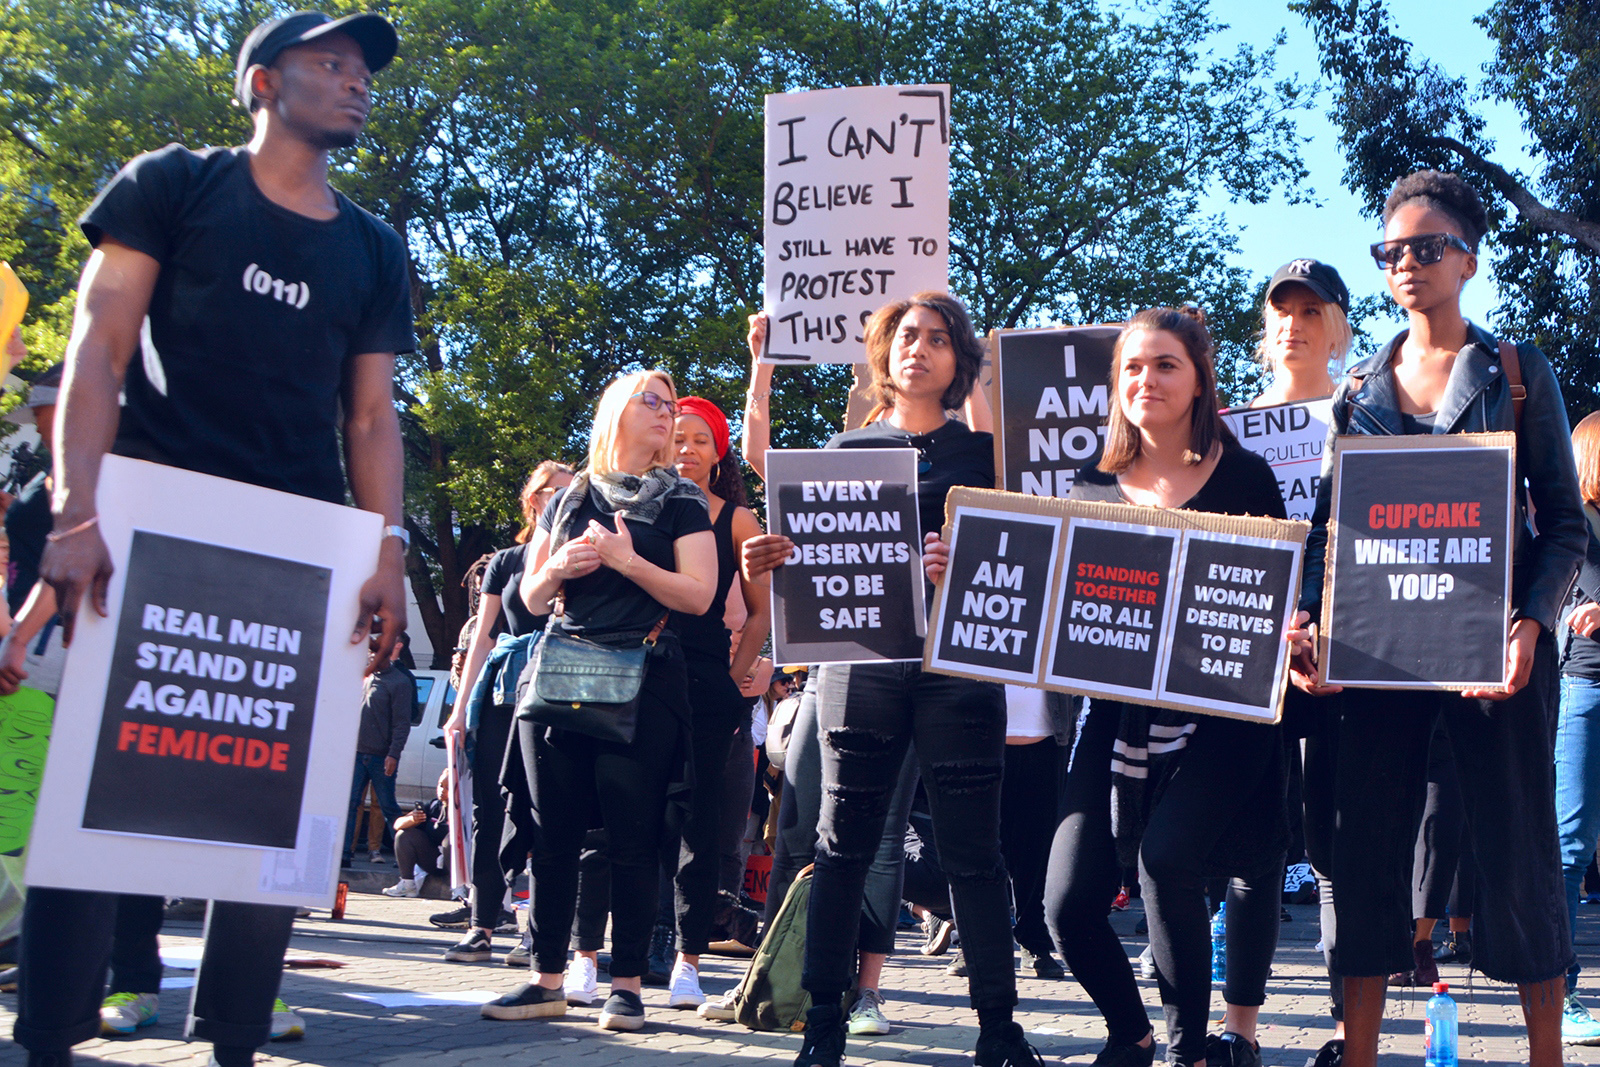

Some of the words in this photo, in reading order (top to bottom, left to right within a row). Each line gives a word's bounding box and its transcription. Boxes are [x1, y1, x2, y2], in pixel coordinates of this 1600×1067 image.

[778, 116, 808, 166] I
[827, 113, 936, 160] CAN'T
[772, 181, 874, 226] BELIEVE
[890, 176, 915, 209] I
[778, 239, 832, 262] STILL
[845, 236, 896, 257] HAVE
[907, 236, 938, 257] TO
[242, 262, 310, 310] (011)
[780, 268, 896, 302] PROTEST
[778, 311, 848, 345] THIS
[1064, 344, 1076, 378] I
[1035, 384, 1109, 419] AM
[1243, 405, 1311, 439] END
[1263, 439, 1326, 463] CULTU
[801, 479, 883, 502] EVERY
[1021, 468, 1082, 498] NE
[786, 511, 901, 534] WOMAN
[1368, 502, 1481, 529] CUPCAKE
[784, 542, 910, 566] DESERVES
[998, 531, 1009, 557] I
[1354, 537, 1440, 565] WHERE
[1443, 537, 1492, 564] ARE
[811, 575, 849, 597] TO
[854, 574, 885, 596] BE
[971, 560, 1024, 591] AM
[1076, 562, 1160, 587] STANDING
[1207, 563, 1267, 587] EVERY
[1387, 573, 1455, 601] YOU?
[961, 590, 1027, 623] NOT
[1074, 580, 1157, 605] TOGETHER
[1194, 584, 1274, 612] WOMAN
[141, 603, 223, 643] REAL
[228, 618, 302, 655] MEN
[819, 606, 881, 630] SAFE
[1070, 600, 1114, 624] FOR
[1116, 605, 1154, 630] ALL
[1185, 607, 1274, 635] DESERVES
[951, 621, 1028, 656] NEXT
[1068, 623, 1151, 653] WOMEN
[1201, 633, 1226, 652] TO
[1229, 637, 1251, 657] BE
[135, 642, 247, 683] STAND
[252, 660, 297, 690] UP
[1200, 657, 1244, 679] SAFE
[124, 680, 295, 731] AGAINST
[117, 720, 290, 772] FEMICIDE
